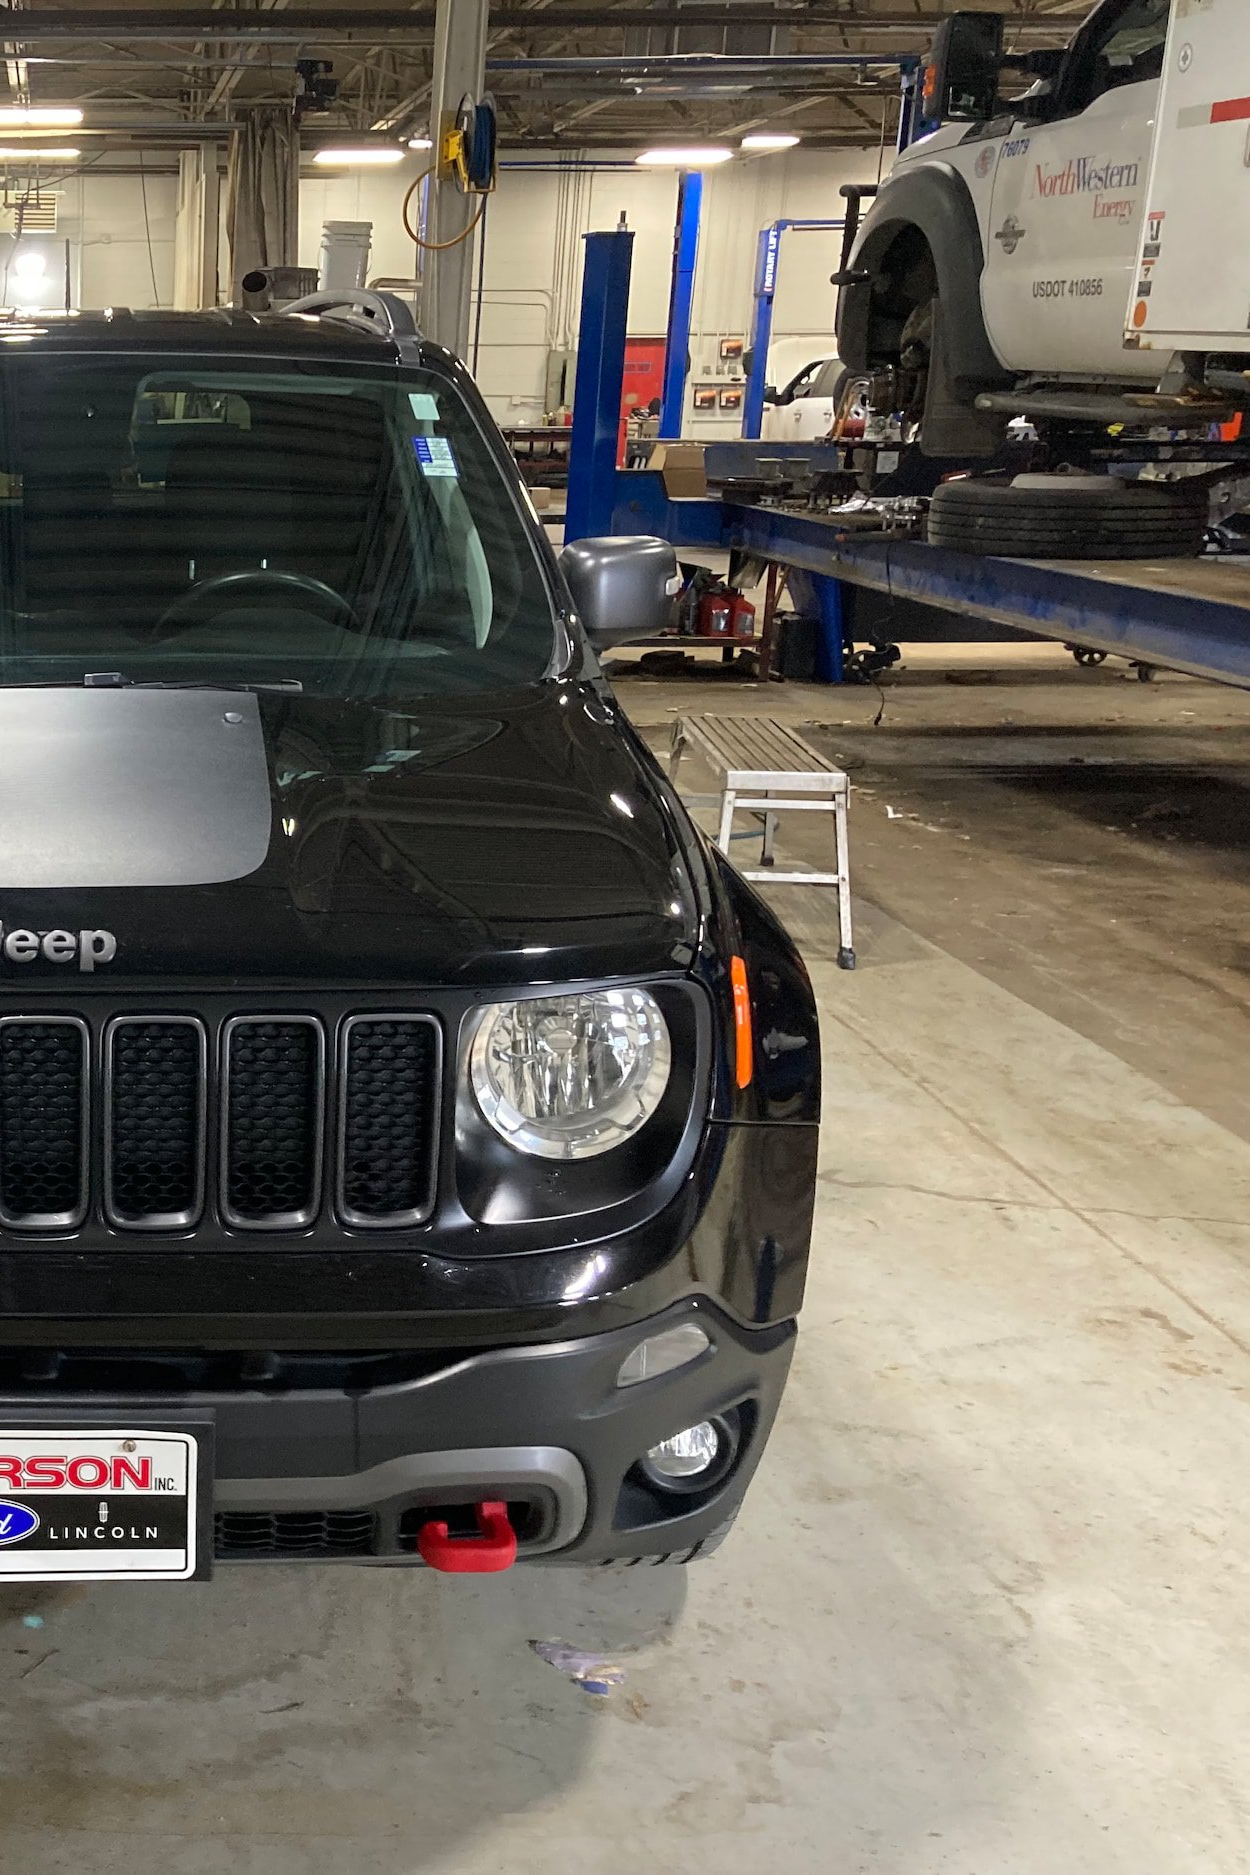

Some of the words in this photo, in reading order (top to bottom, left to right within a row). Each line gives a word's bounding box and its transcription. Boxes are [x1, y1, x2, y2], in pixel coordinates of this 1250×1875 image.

[1003, 139, 1030, 158] 76079
[1033, 155, 1139, 198] NorthWestern
[1093, 193, 1135, 225] Energy
[764, 251, 776, 287] ROTARY
[1032, 280, 1067, 297] USDOT
[1068, 278, 1103, 296] 410856
[154, 1477, 178, 1491] INC.
[49, 1526, 159, 1540] LINCOLN
